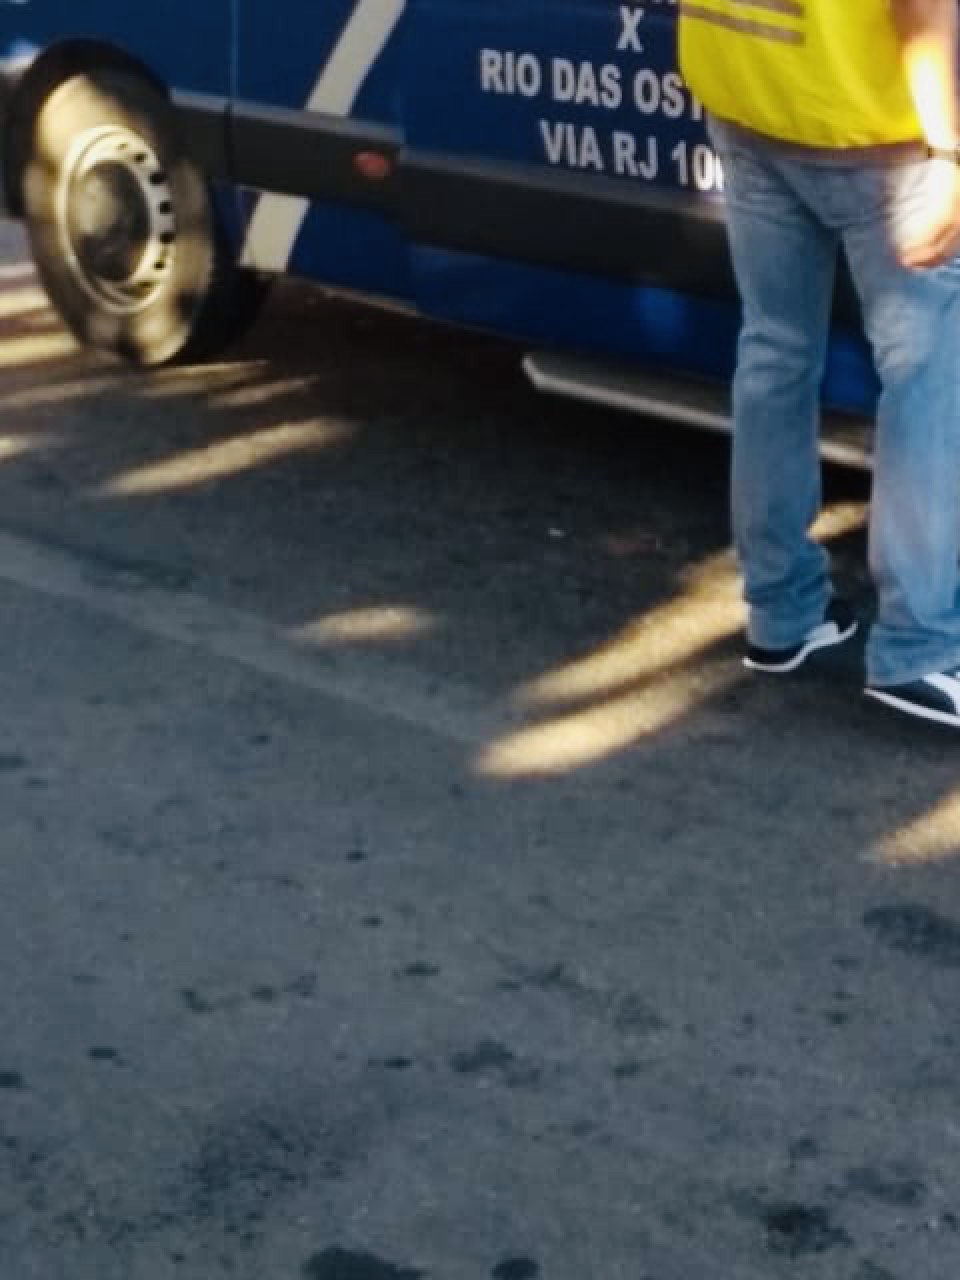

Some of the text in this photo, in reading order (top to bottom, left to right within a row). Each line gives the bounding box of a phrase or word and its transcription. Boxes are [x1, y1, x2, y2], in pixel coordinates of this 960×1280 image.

[616, 6, 645, 52] X
[480, 49, 541, 97] RIO
[553, 58, 622, 108] DAS
[540, 118, 603, 170] VIA
[612, 131, 658, 180] RJ
